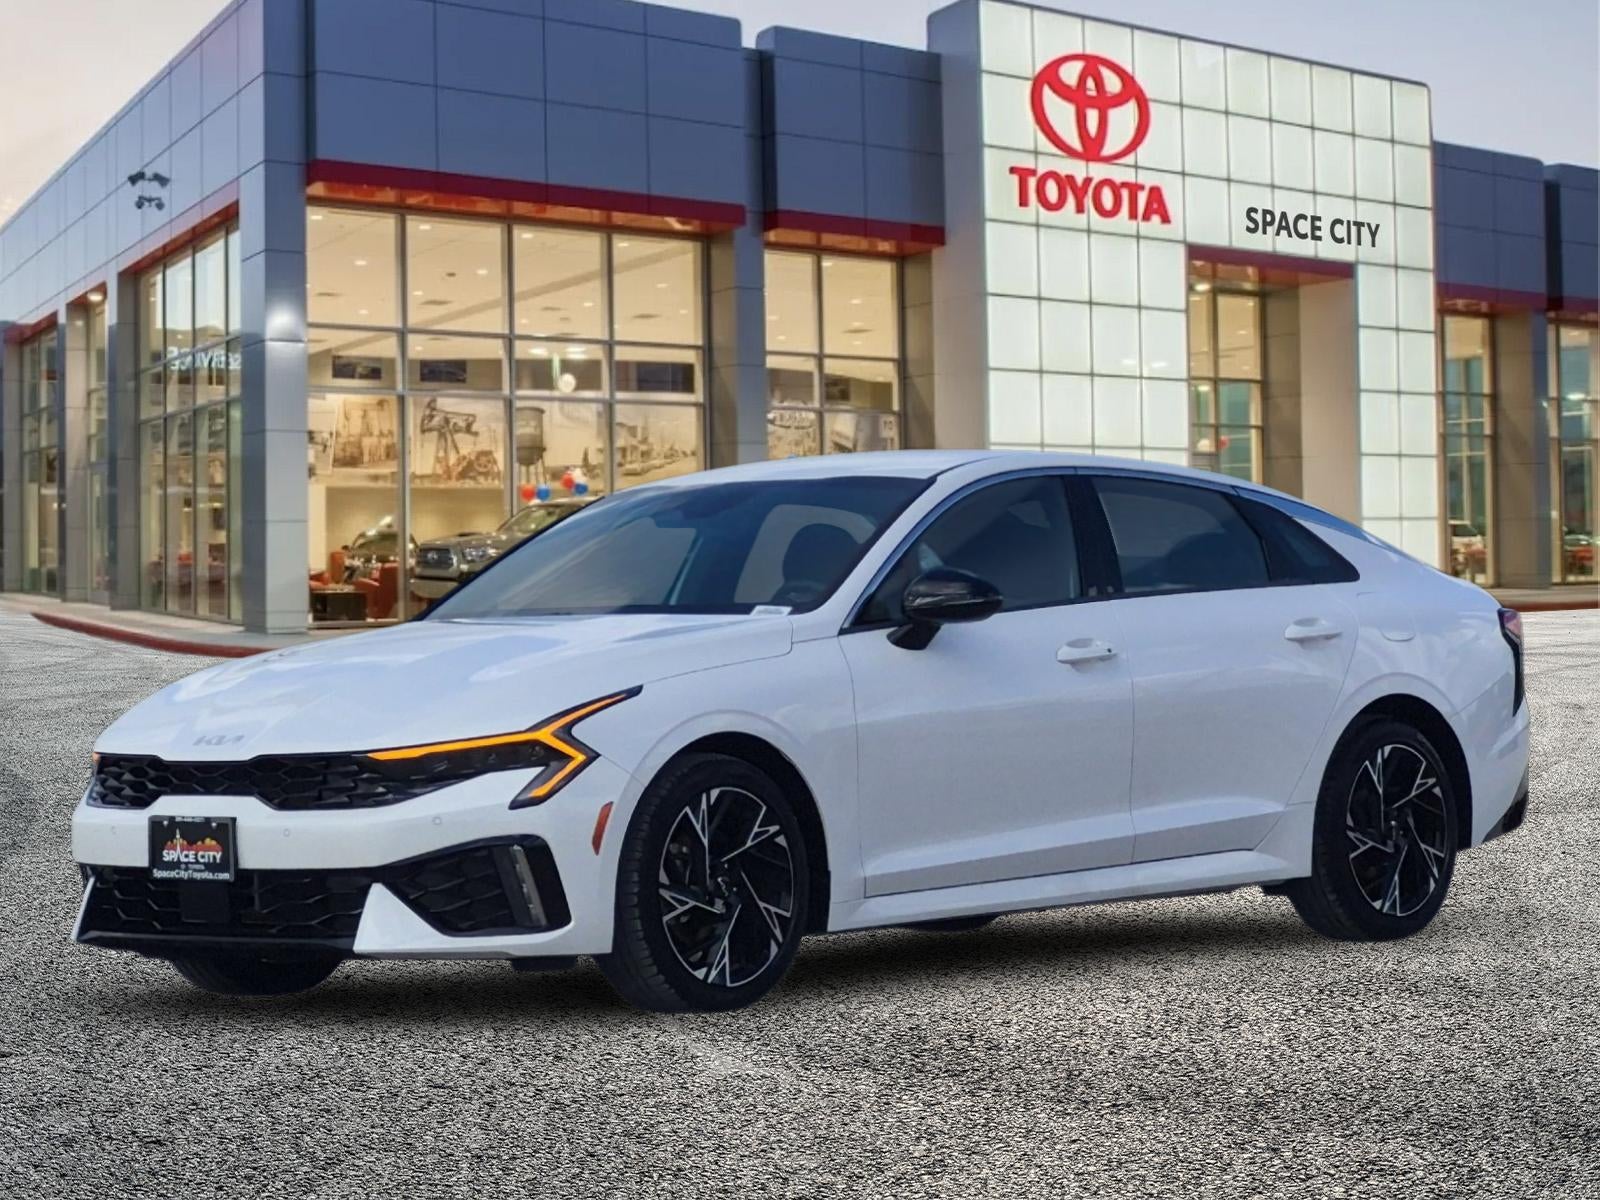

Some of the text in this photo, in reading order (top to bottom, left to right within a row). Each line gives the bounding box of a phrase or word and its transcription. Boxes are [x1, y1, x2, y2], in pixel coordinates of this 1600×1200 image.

[1009, 166, 1171, 224] TOYOTA
[1245, 207, 1380, 248] SPACE CITY
[162, 850, 222, 863] SPACE CITY
[153, 868, 230, 881] SpaceCityToyota.com
